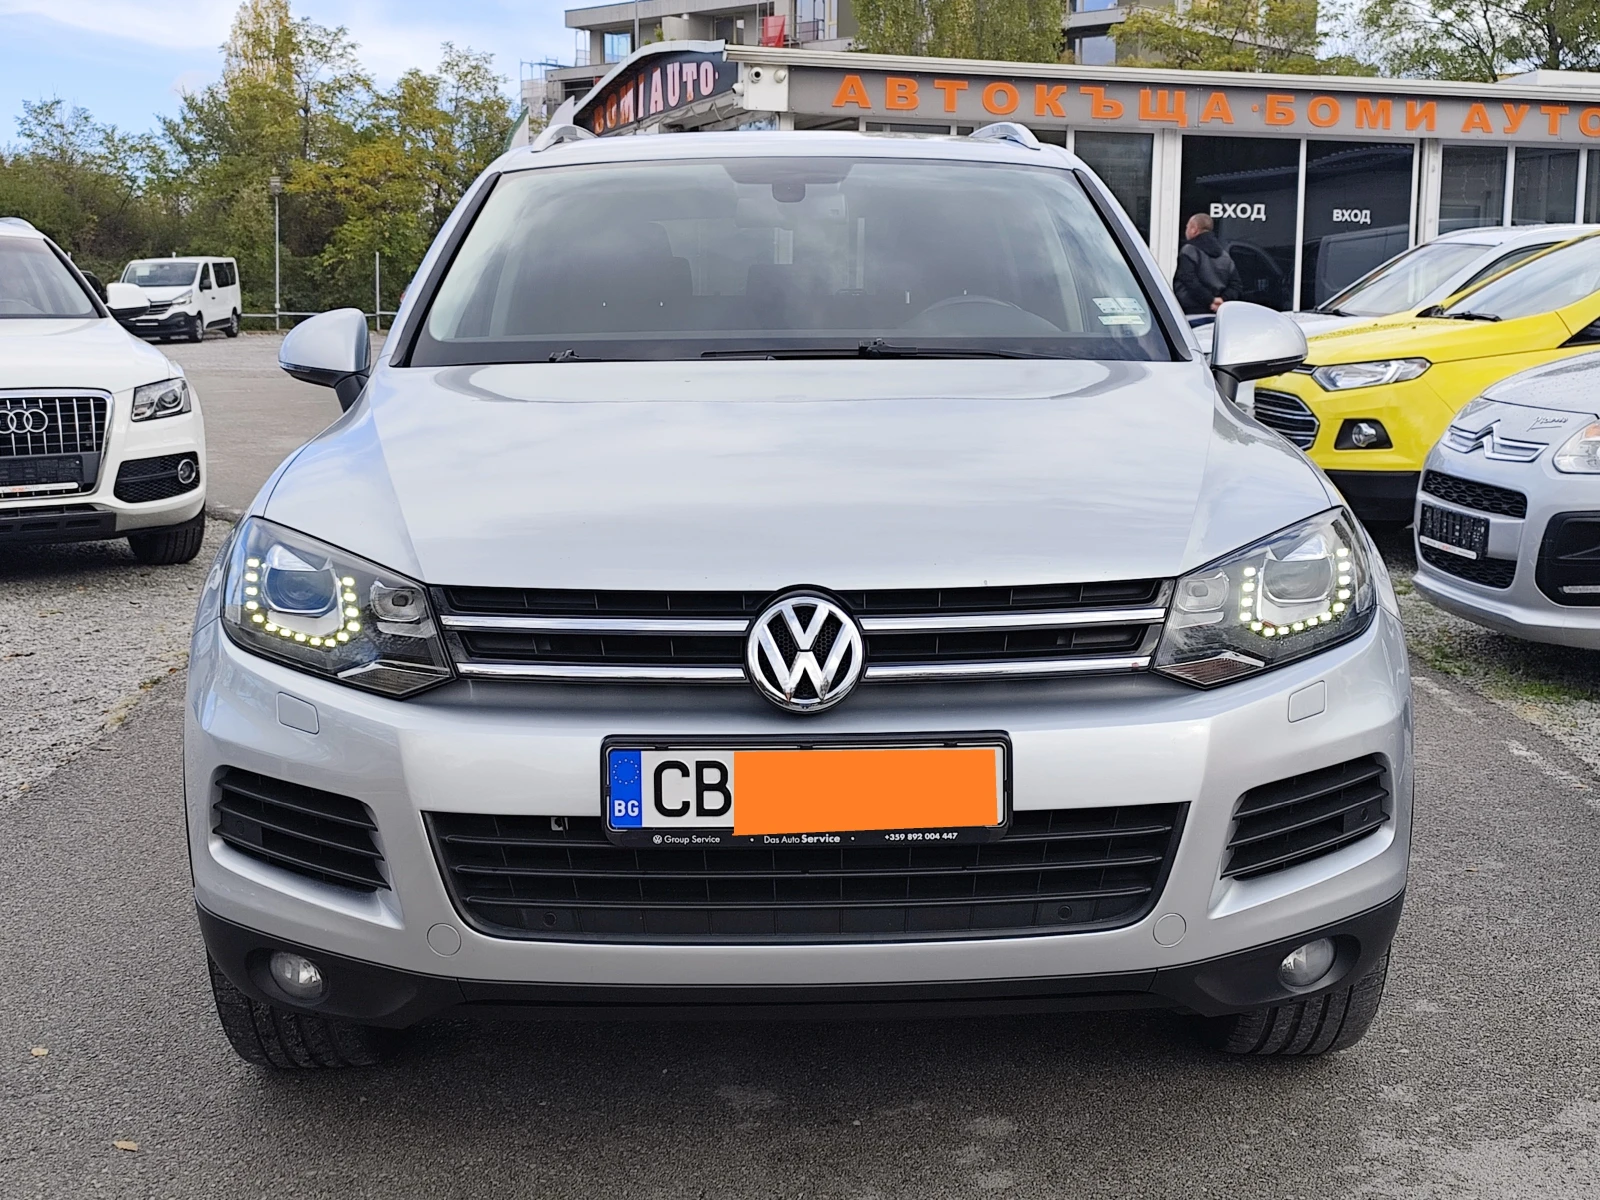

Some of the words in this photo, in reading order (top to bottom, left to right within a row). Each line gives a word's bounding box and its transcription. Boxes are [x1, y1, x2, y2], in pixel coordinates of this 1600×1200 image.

[832, 75, 1234, 127] АВТОКЪЩА
[1265, 94, 1436, 131] БОМИ
[1461, 103, 1600, 137] АУТО
[1210, 203, 1266, 221] ВХОД
[1333, 209, 1371, 224] ВХОД
[614, 800, 639, 817] BG
[664, 835, 690, 845] Group
[691, 835, 721, 843] Service
[763, 835, 780, 844] Das
[782, 835, 800, 844] Auto
[801, 834, 841, 843] Service
[884, 833, 907, 841] +359
[907, 832, 923, 840] 892
[924, 832, 941, 840] 004
[942, 832, 958, 840] 447
